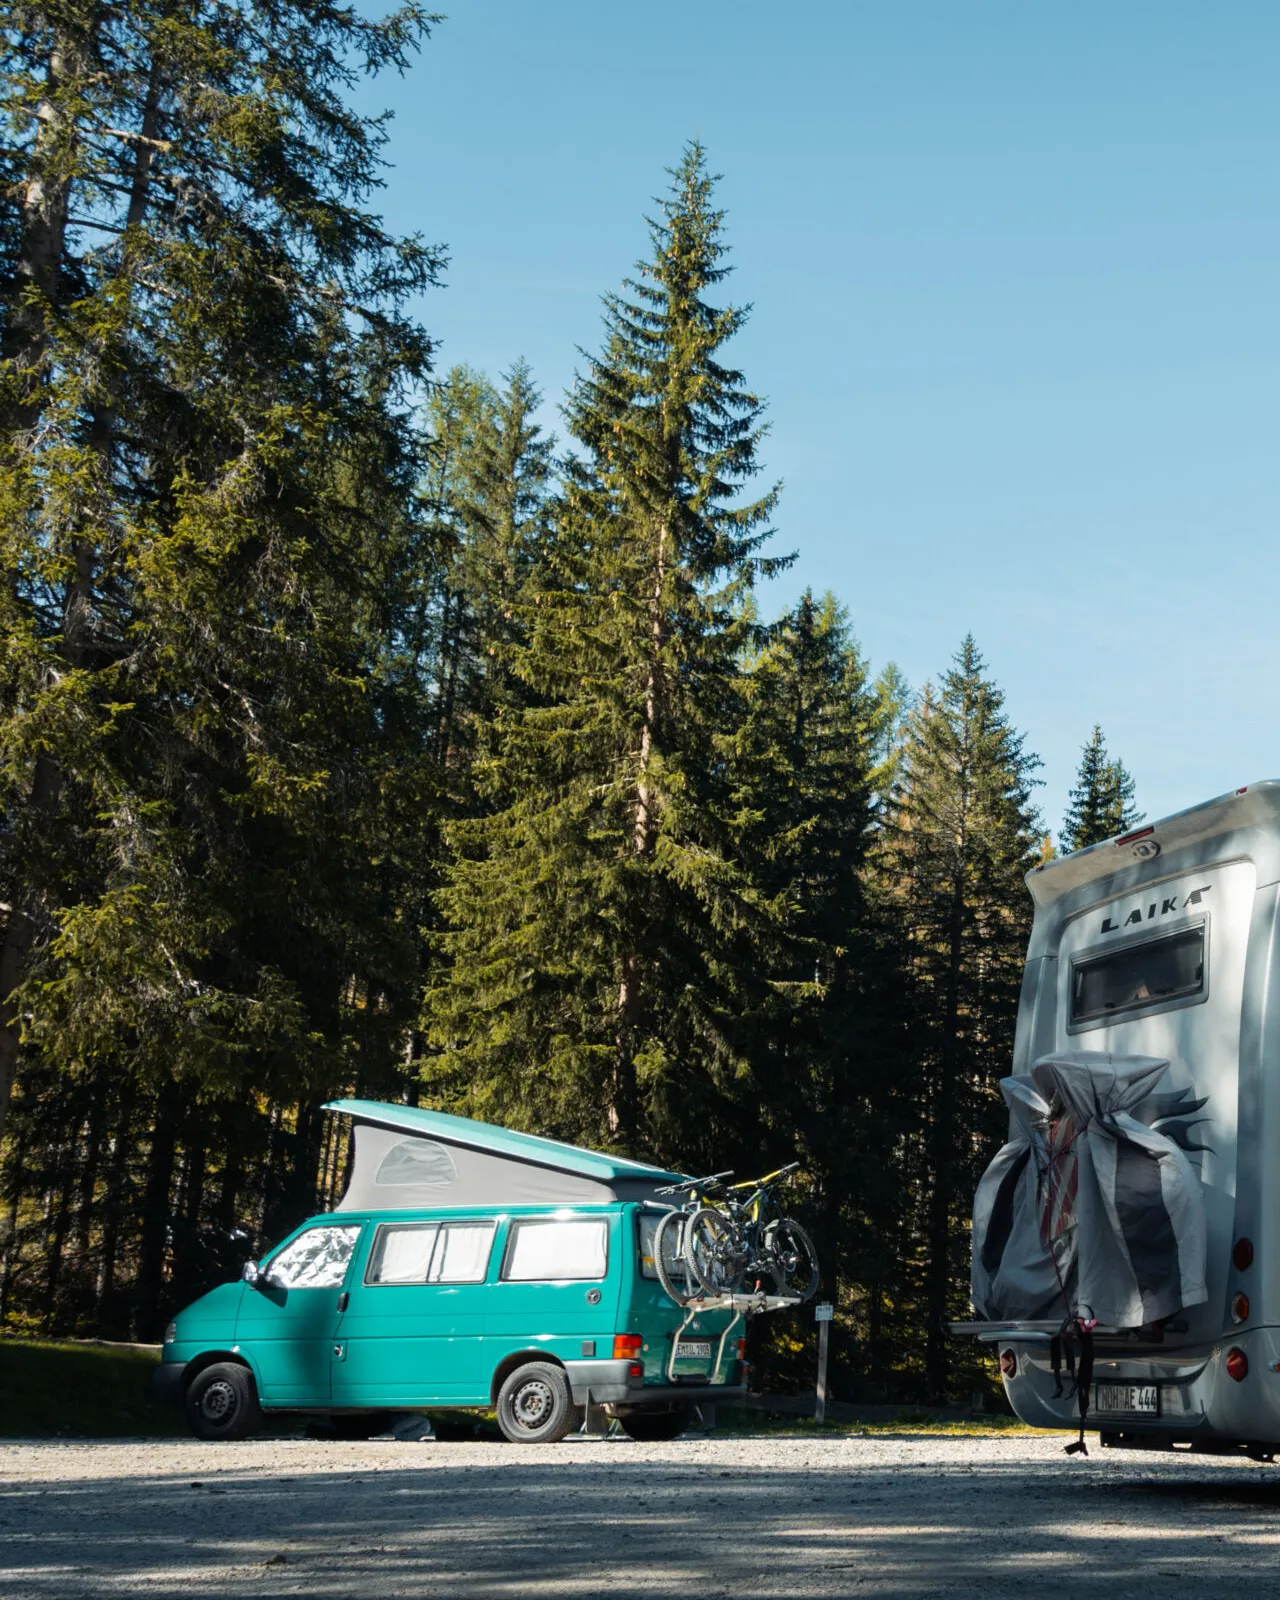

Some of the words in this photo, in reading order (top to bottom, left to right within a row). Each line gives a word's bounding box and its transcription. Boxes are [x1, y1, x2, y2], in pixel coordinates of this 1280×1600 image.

[1100, 885, 1212, 934] LAIKA
[1101, 1387, 1119, 1409] NOH
[1124, 1387, 1136, 1409] AE
[1138, 1387, 1157, 1410] 444
